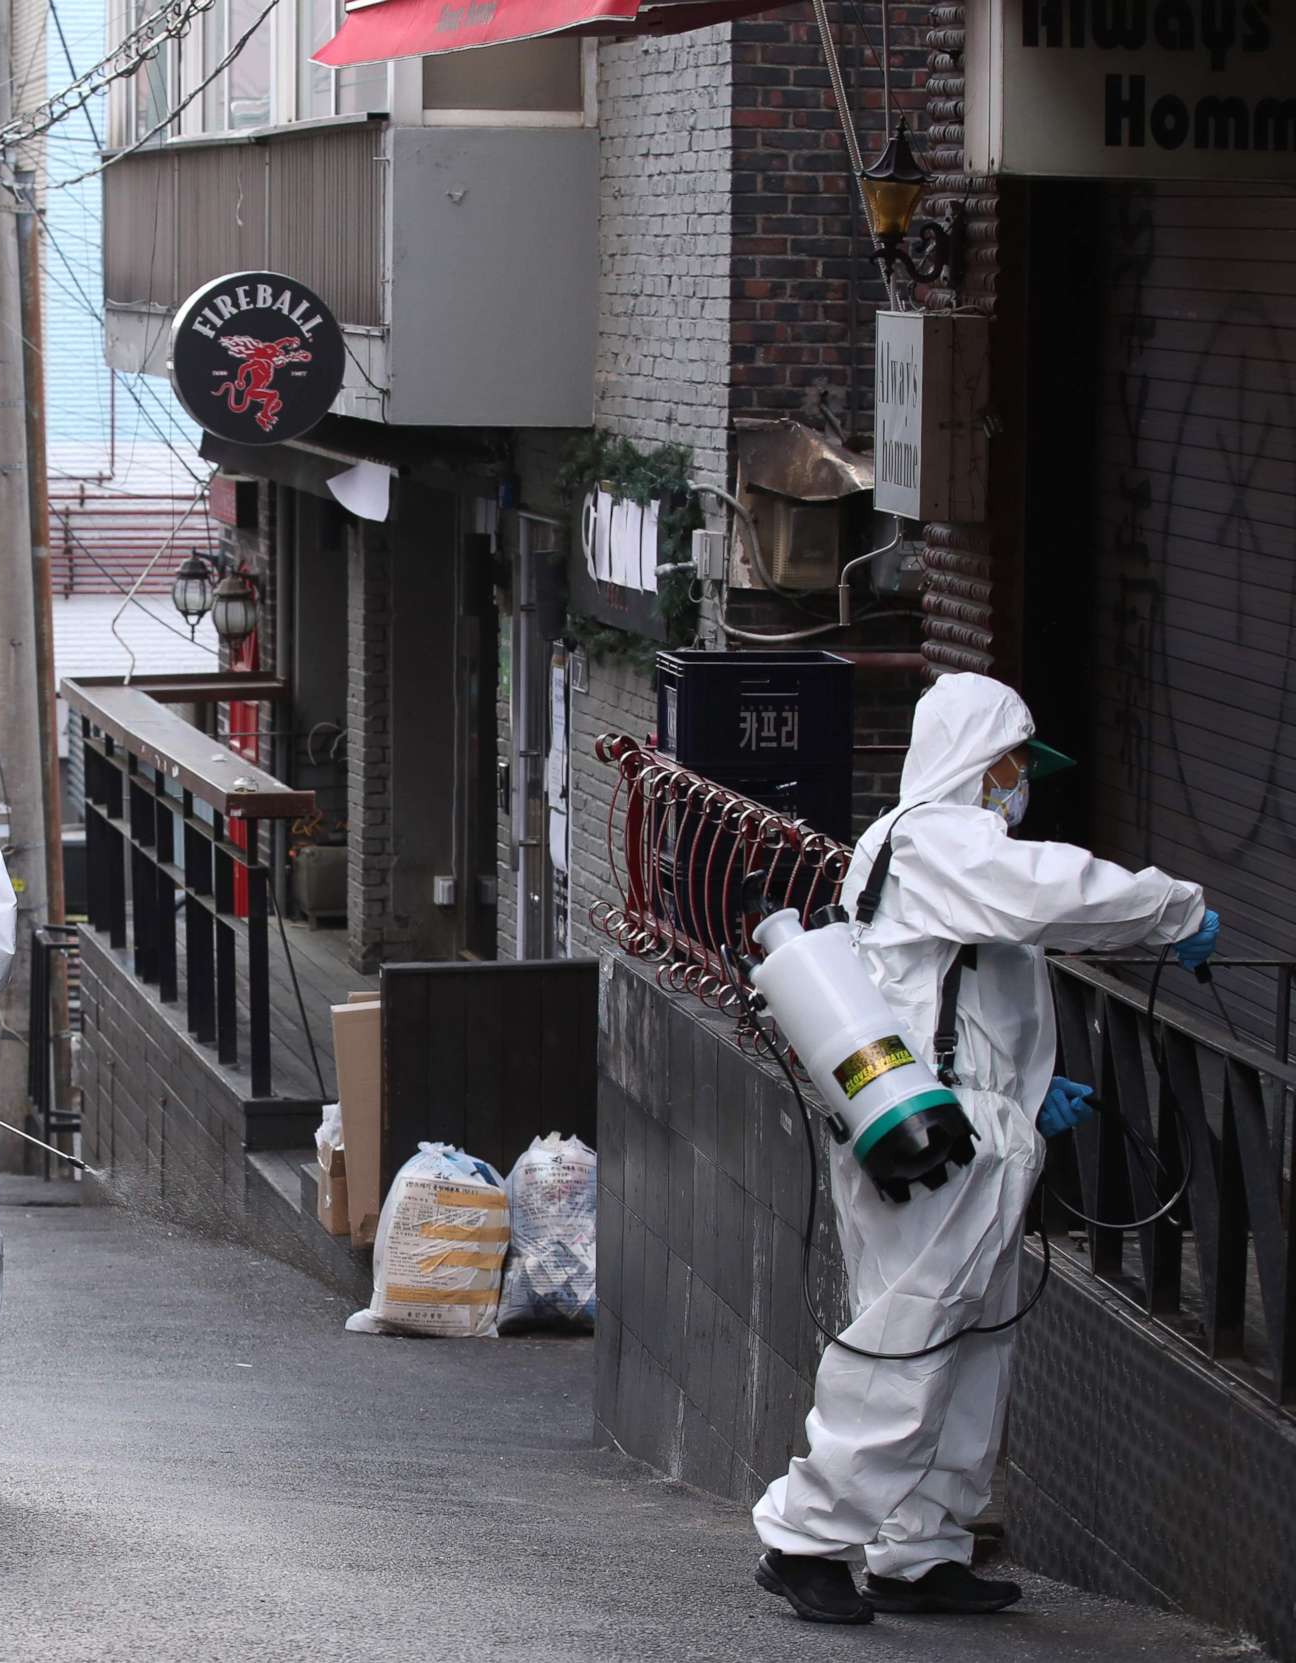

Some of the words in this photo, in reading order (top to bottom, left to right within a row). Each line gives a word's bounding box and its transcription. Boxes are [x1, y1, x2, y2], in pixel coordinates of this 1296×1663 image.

[192, 284, 323, 339] FIREBALL
[881, 418, 918, 489] homme
[739, 711, 799, 751] 카프리
[845, 1064, 875, 1091] CLOVER
